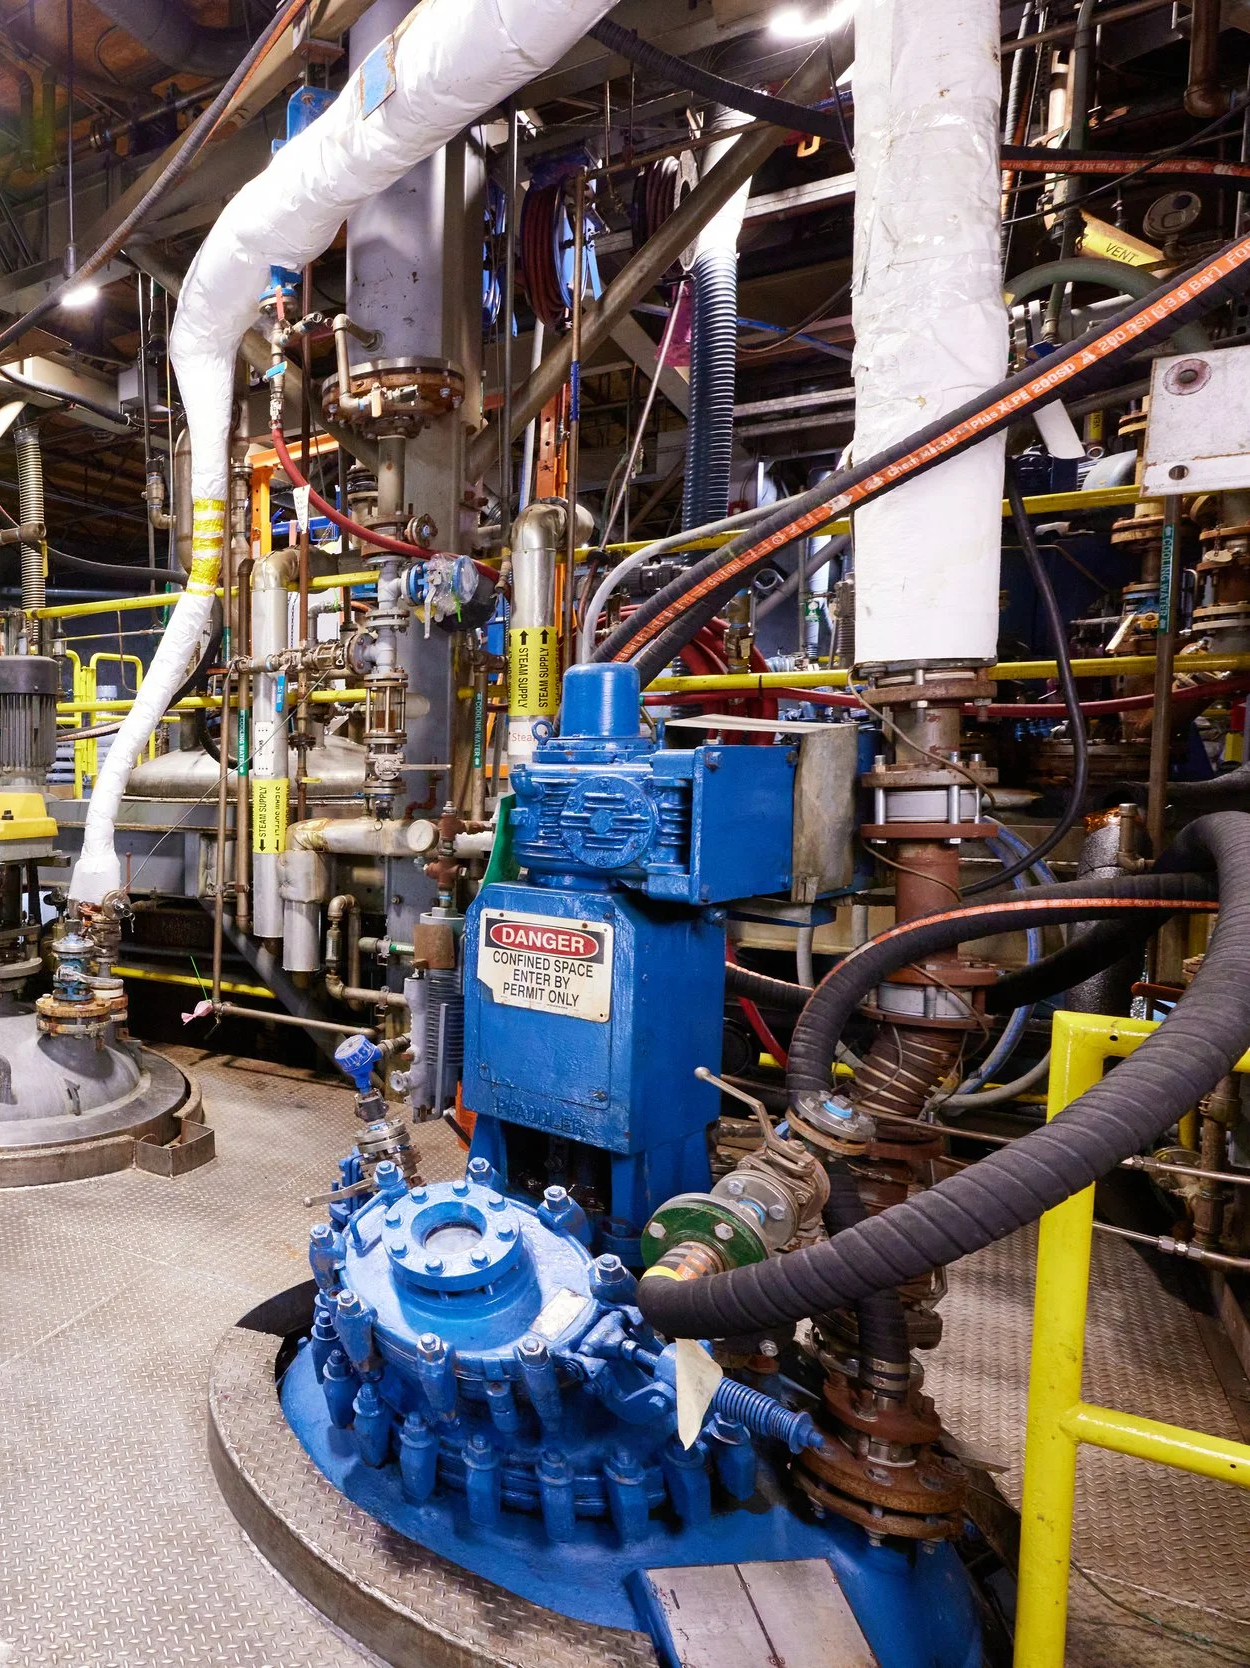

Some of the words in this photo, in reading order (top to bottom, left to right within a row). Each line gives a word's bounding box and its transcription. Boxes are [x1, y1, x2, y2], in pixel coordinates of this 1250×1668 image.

[1105, 242, 1139, 263] VENT
[970, 409, 999, 430] Plus
[998, 389, 1031, 412] XLPE
[1031, 362, 1076, 394] 200SD
[1098, 331, 1127, 352] 200
[1126, 315, 1151, 335] PSI
[1161, 538, 1172, 581] COOLING
[1160, 582, 1170, 617] WATER
[518, 647, 529, 676] STEAM
[539, 647, 549, 679] SUPPLY
[518, 677, 528, 709] SUPPLY
[538, 682, 549, 708] STEAM
[259, 786, 267, 812] SUPPLY
[259, 813, 267, 838] STEAM
[502, 927, 585, 954] DANGER
[493, 951, 550, 970] CONFINED
[554, 960, 594, 978] SPACE
[513, 969, 550, 986] ENTER
[554, 975, 570, 990] BY
[503, 982, 545, 1001] PERMIT
[549, 990, 579, 1007] ONLY
